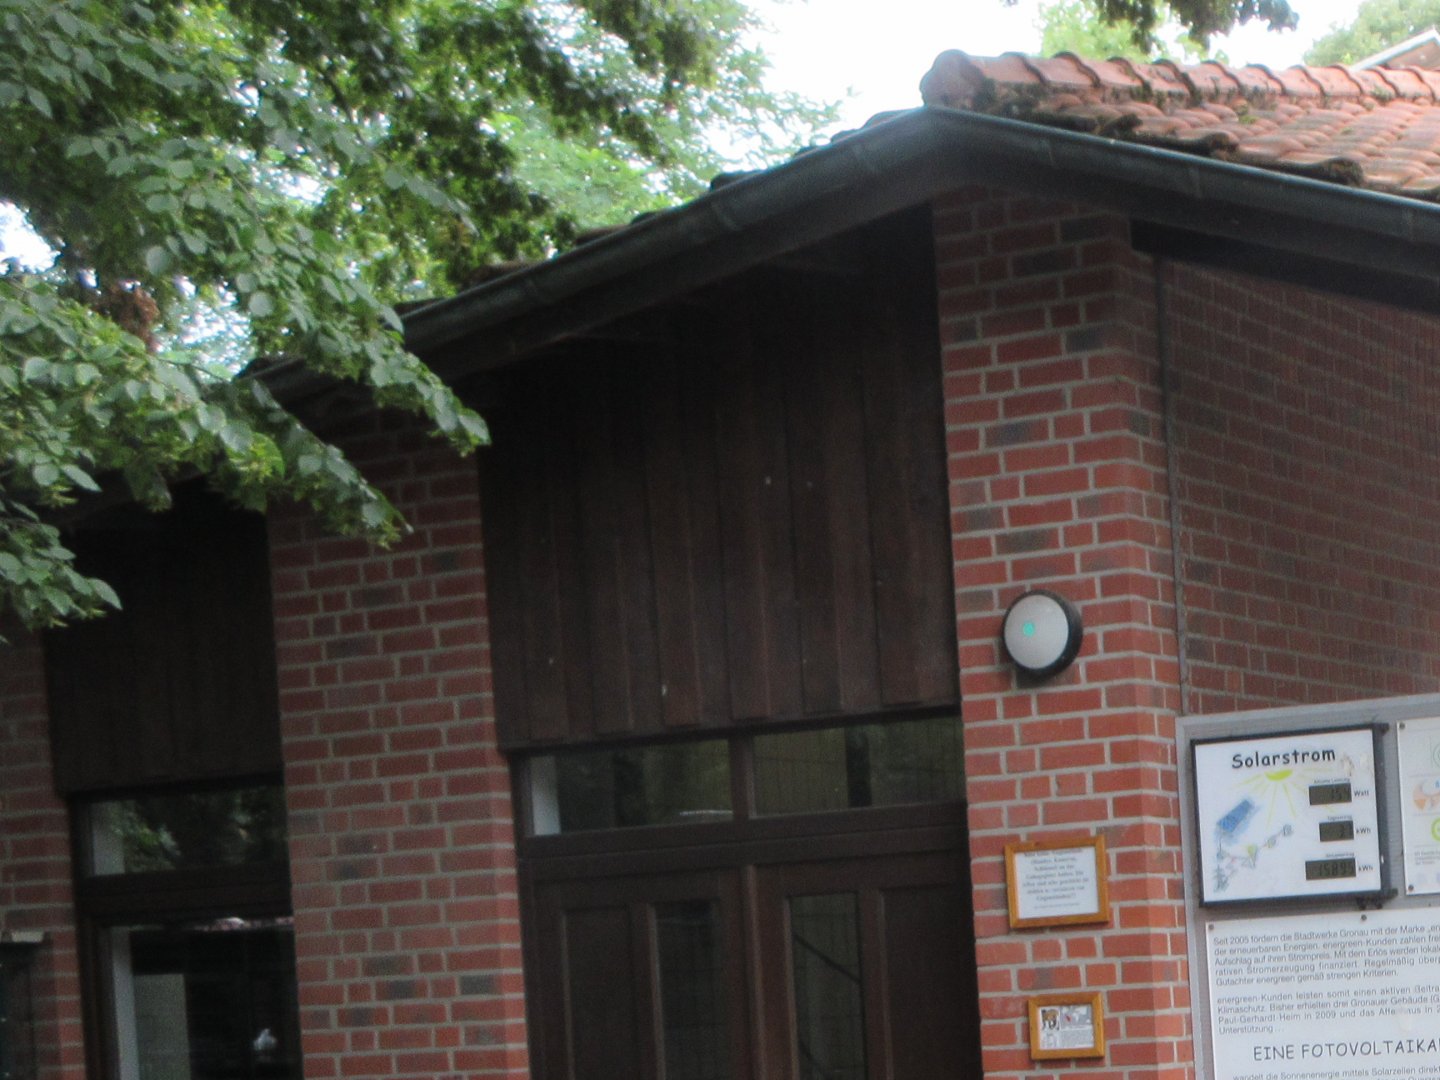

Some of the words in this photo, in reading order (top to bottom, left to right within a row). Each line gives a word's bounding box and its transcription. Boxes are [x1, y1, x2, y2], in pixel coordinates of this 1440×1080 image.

[1231, 748, 1336, 769] Solarstrom
[1354, 789, 1369, 797] Watt
[1355, 826, 1371, 835] kWh
[1358, 863, 1374, 872] kWh
[1213, 937, 1227, 945] Seit
[1229, 936, 1249, 944] 2005
[1280, 933, 1292, 941] die
[1293, 930, 1337, 940] Stadtwerke
[1339, 928, 1368, 937] Gronau
[1370, 927, 1382, 935] mit
[1384, 926, 1398, 934] der
[1399, 924, 1424, 933] Marke
[1213, 947, 1227, 955] der
[1229, 944, 1281, 954] erneuerbaren
[1214, 956, 1251, 967] Aufschlag
[1253, 955, 1265, 963] auf
[1267, 954, 1286, 962] ihren
[1333, 950, 1347, 958] Mit
[1347, 949, 1365, 957] dem
[1389, 946, 1418, 954] werden
[1215, 967, 1242, 976] rativen
[1246, 963, 1315, 975] Stromerzeugung
[1364, 957, 1414, 968] Regelmäßig
[1215, 976, 1254, 986] Gutachter
[1256, 976, 1295, 985] energreen
[1325, 970, 1361, 981] strengen
[1295, 991, 1323, 999] leisten
[1326, 989, 1350, 998] somit
[1353, 988, 1376, 996] einen
[1379, 986, 1411, 995] aktiven
[1269, 1003, 1294, 1011] Bisher
[1296, 1001, 1331, 1010] erhielten
[1350, 997, 1387, 1007] Gronauer
[1303, 1011, 1311, 1019] in
[1314, 1010, 1336, 1019] 2009
[1341, 1009, 1356, 1017] und
[1359, 1008, 1374, 1016] das
[1424, 1004, 1432, 1013] in
[1253, 1044, 1295, 1061] EINE
[1265, 1072, 1278, 1080] die
[1280, 1069, 1339, 1080] Sonnenenergie
[1341, 1068, 1368, 1077] mittels
[1371, 1065, 1416, 1075] Solarzellen
[1418, 1064, 1440, 1073] direkt
